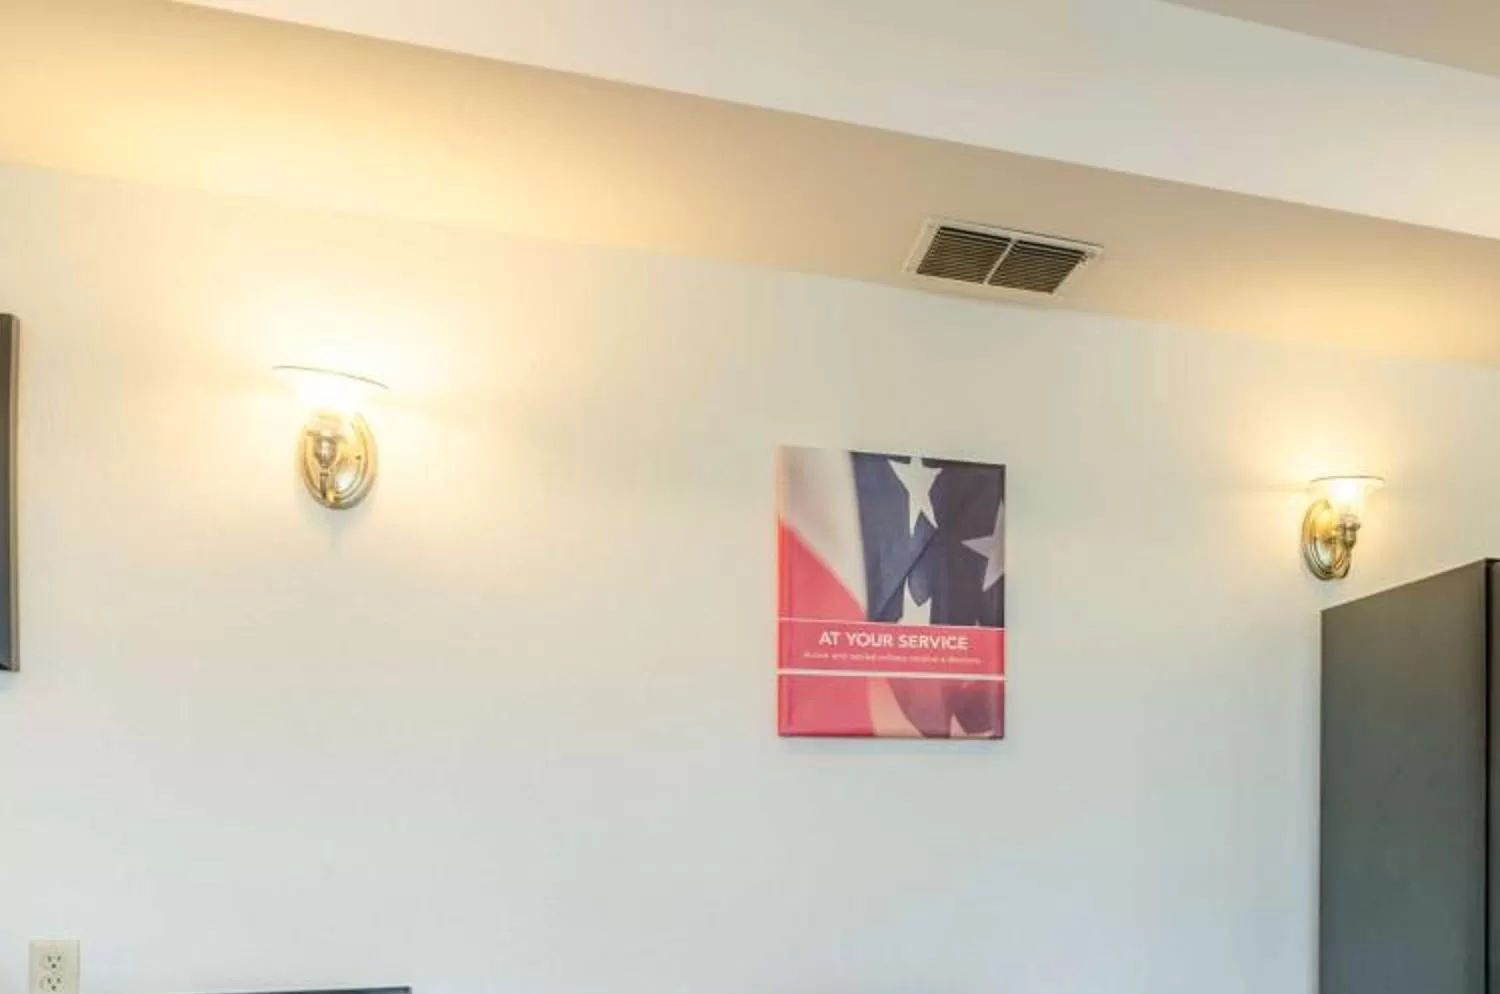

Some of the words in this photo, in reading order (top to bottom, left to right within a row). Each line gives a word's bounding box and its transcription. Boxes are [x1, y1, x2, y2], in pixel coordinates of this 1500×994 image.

[818, 631, 841, 646] AT
[844, 632, 894, 648] YOUR
[898, 634, 969, 650] SERVICE
